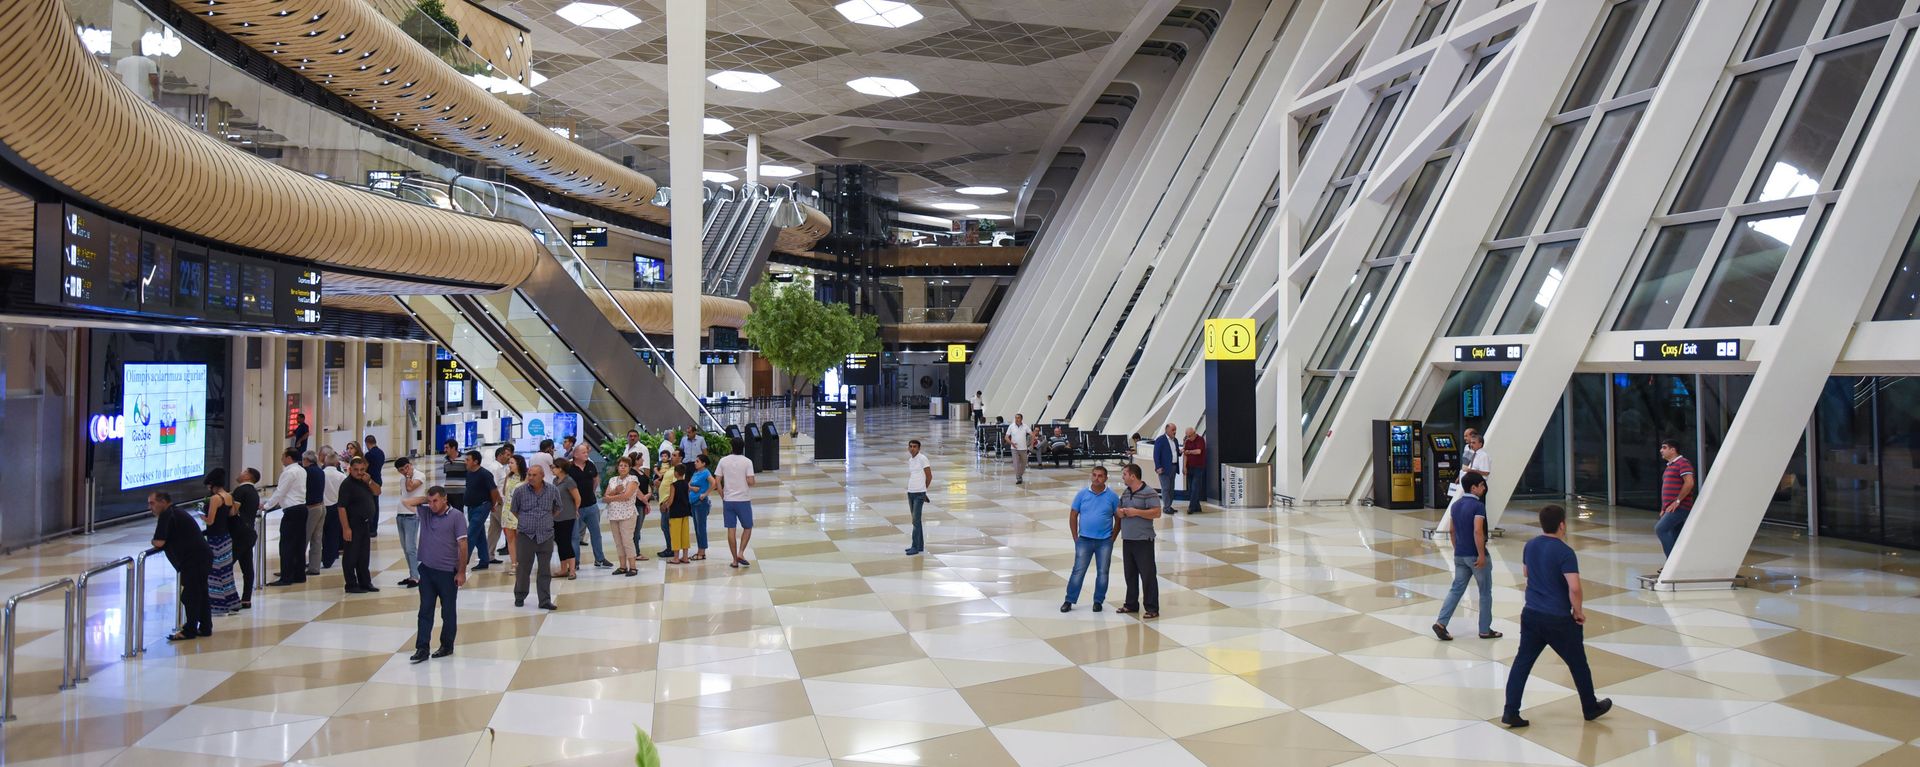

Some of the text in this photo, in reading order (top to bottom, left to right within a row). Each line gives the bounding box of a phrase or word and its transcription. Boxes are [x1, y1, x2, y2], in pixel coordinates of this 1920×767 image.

[1486, 347, 1496, 357] Exit
[1683, 343, 1698, 355] Exit
[450, 361, 457, 369] B
[124, 469, 154, 485] Successes
[155, 469, 162, 480] to
[163, 467, 173, 479] our
